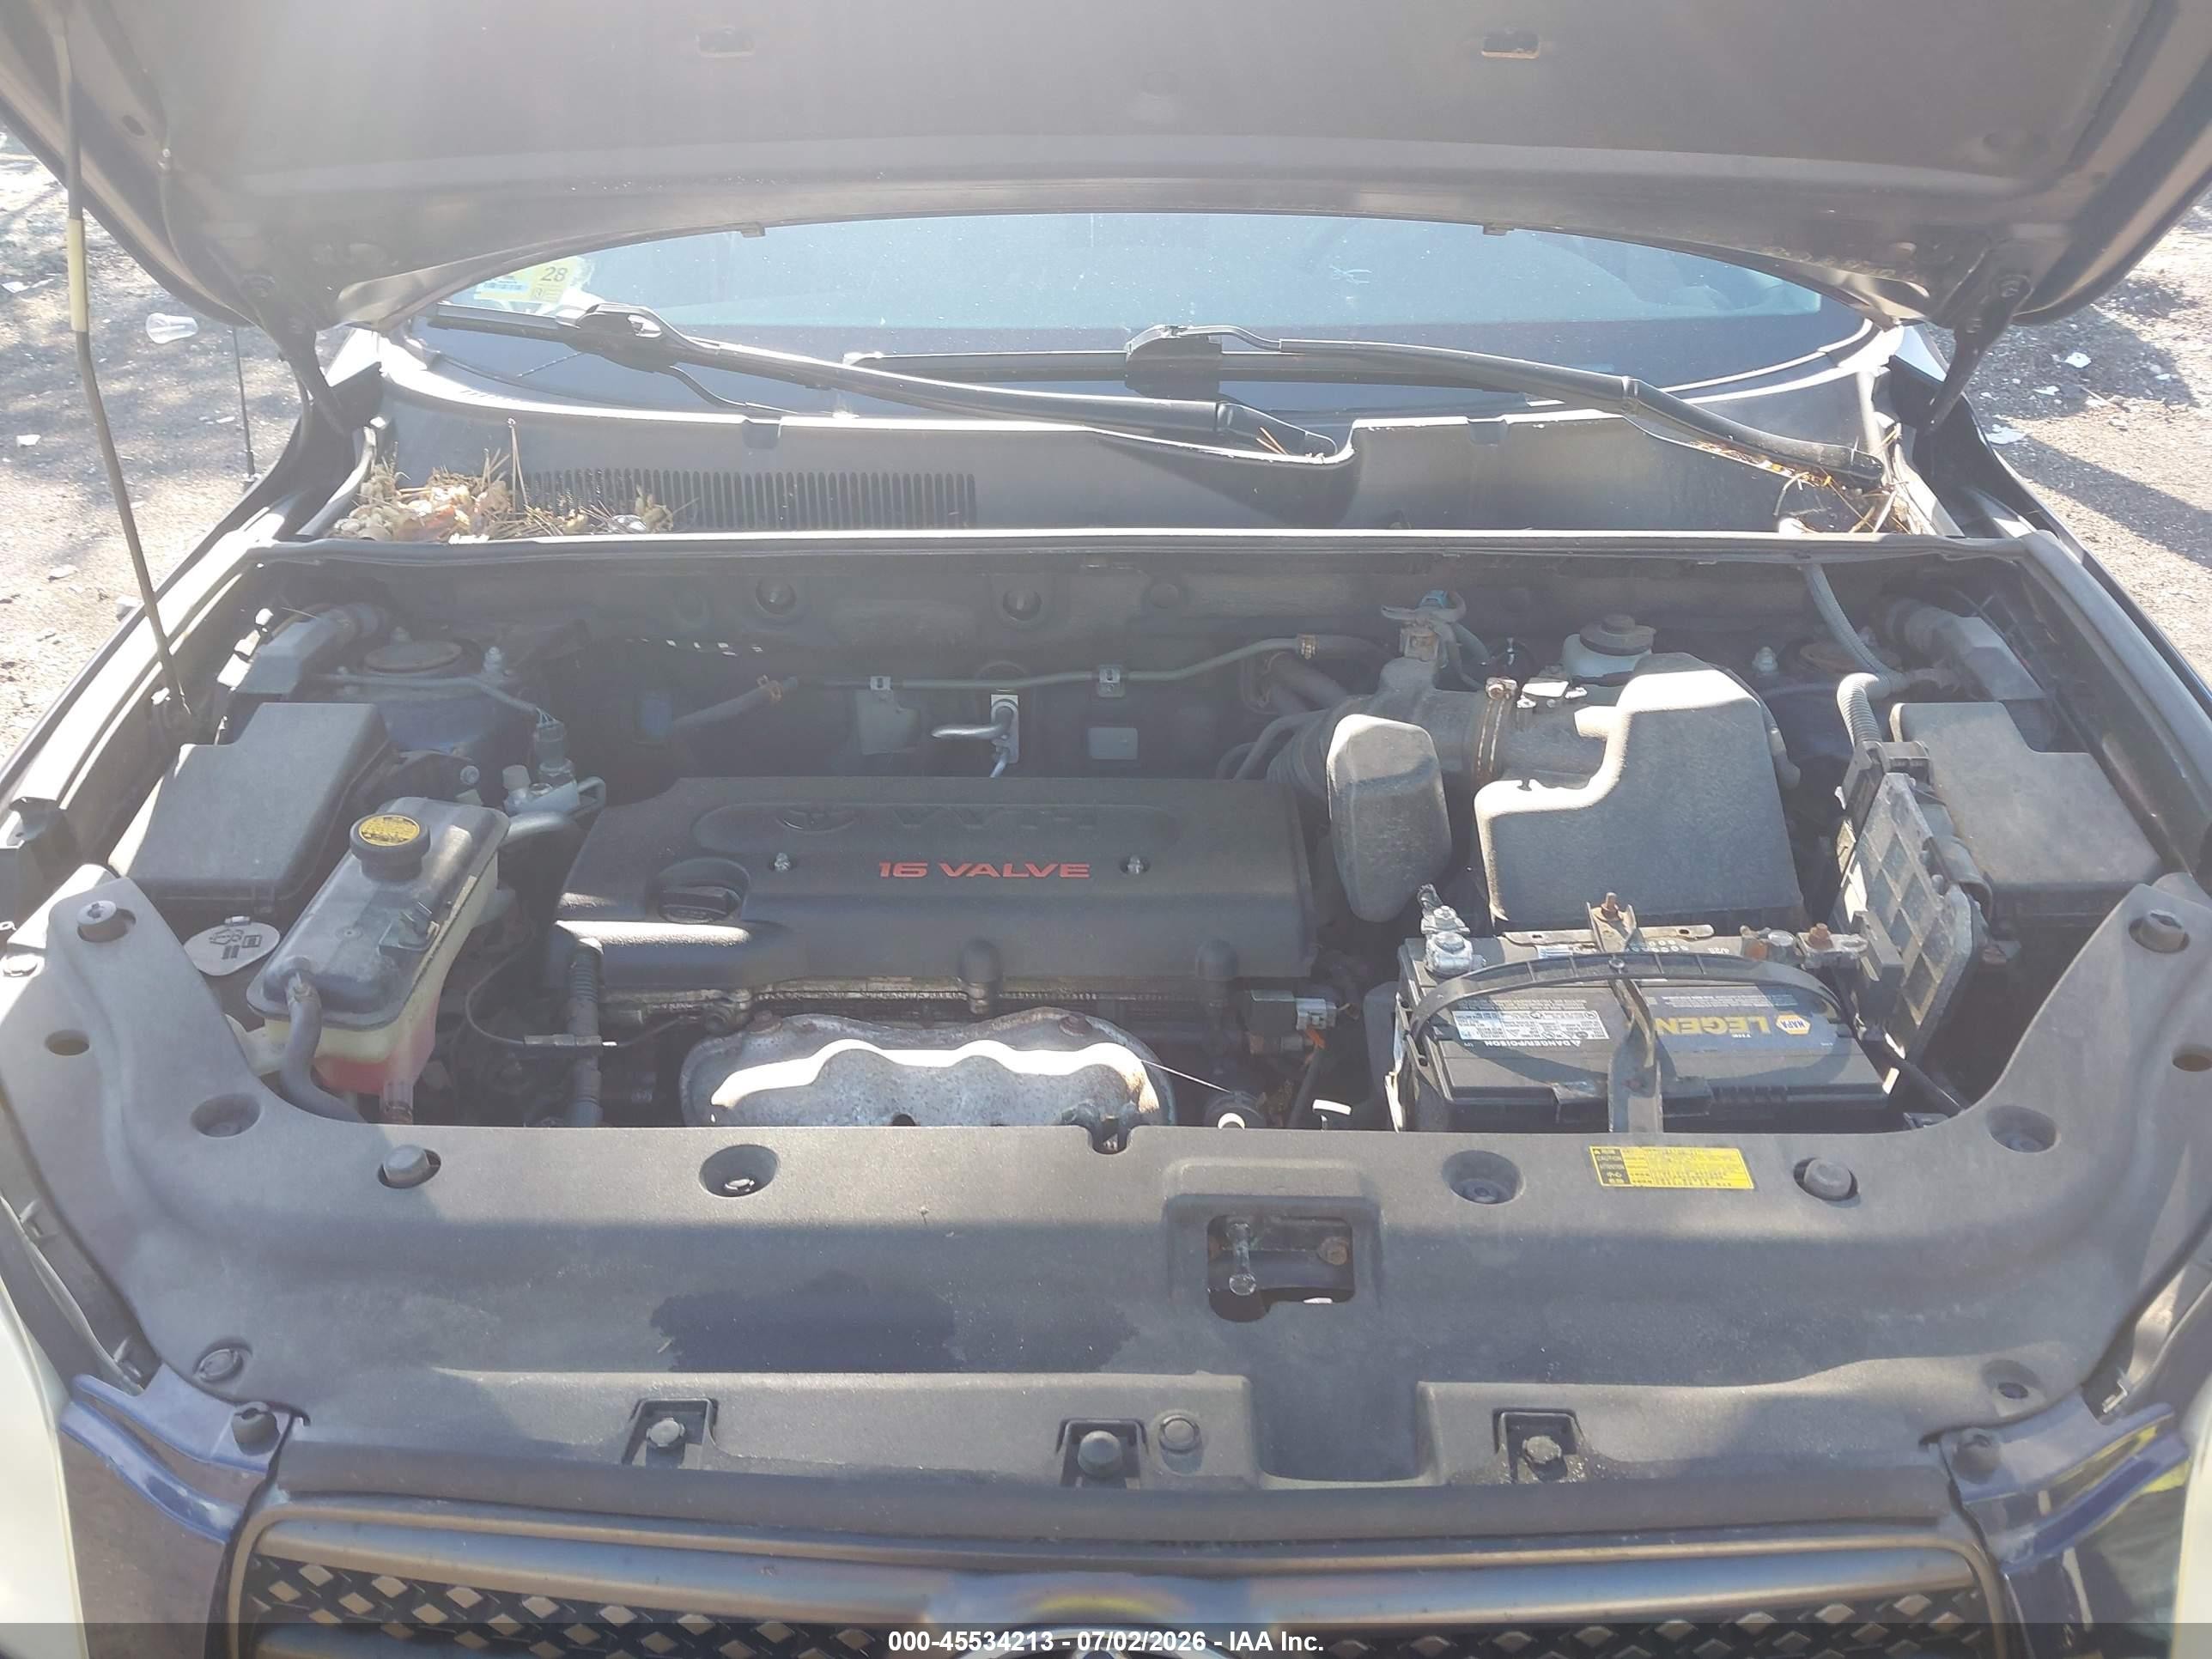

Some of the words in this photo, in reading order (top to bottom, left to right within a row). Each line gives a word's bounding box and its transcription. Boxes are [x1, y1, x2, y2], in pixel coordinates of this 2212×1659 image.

[540, 267, 568, 283] 28
[878, 861, 928, 878] 16
[939, 861, 1091, 878] VALVE
[1654, 1016, 1771, 1035] LEGEN
[1780, 1019, 1805, 1029] NAPA
